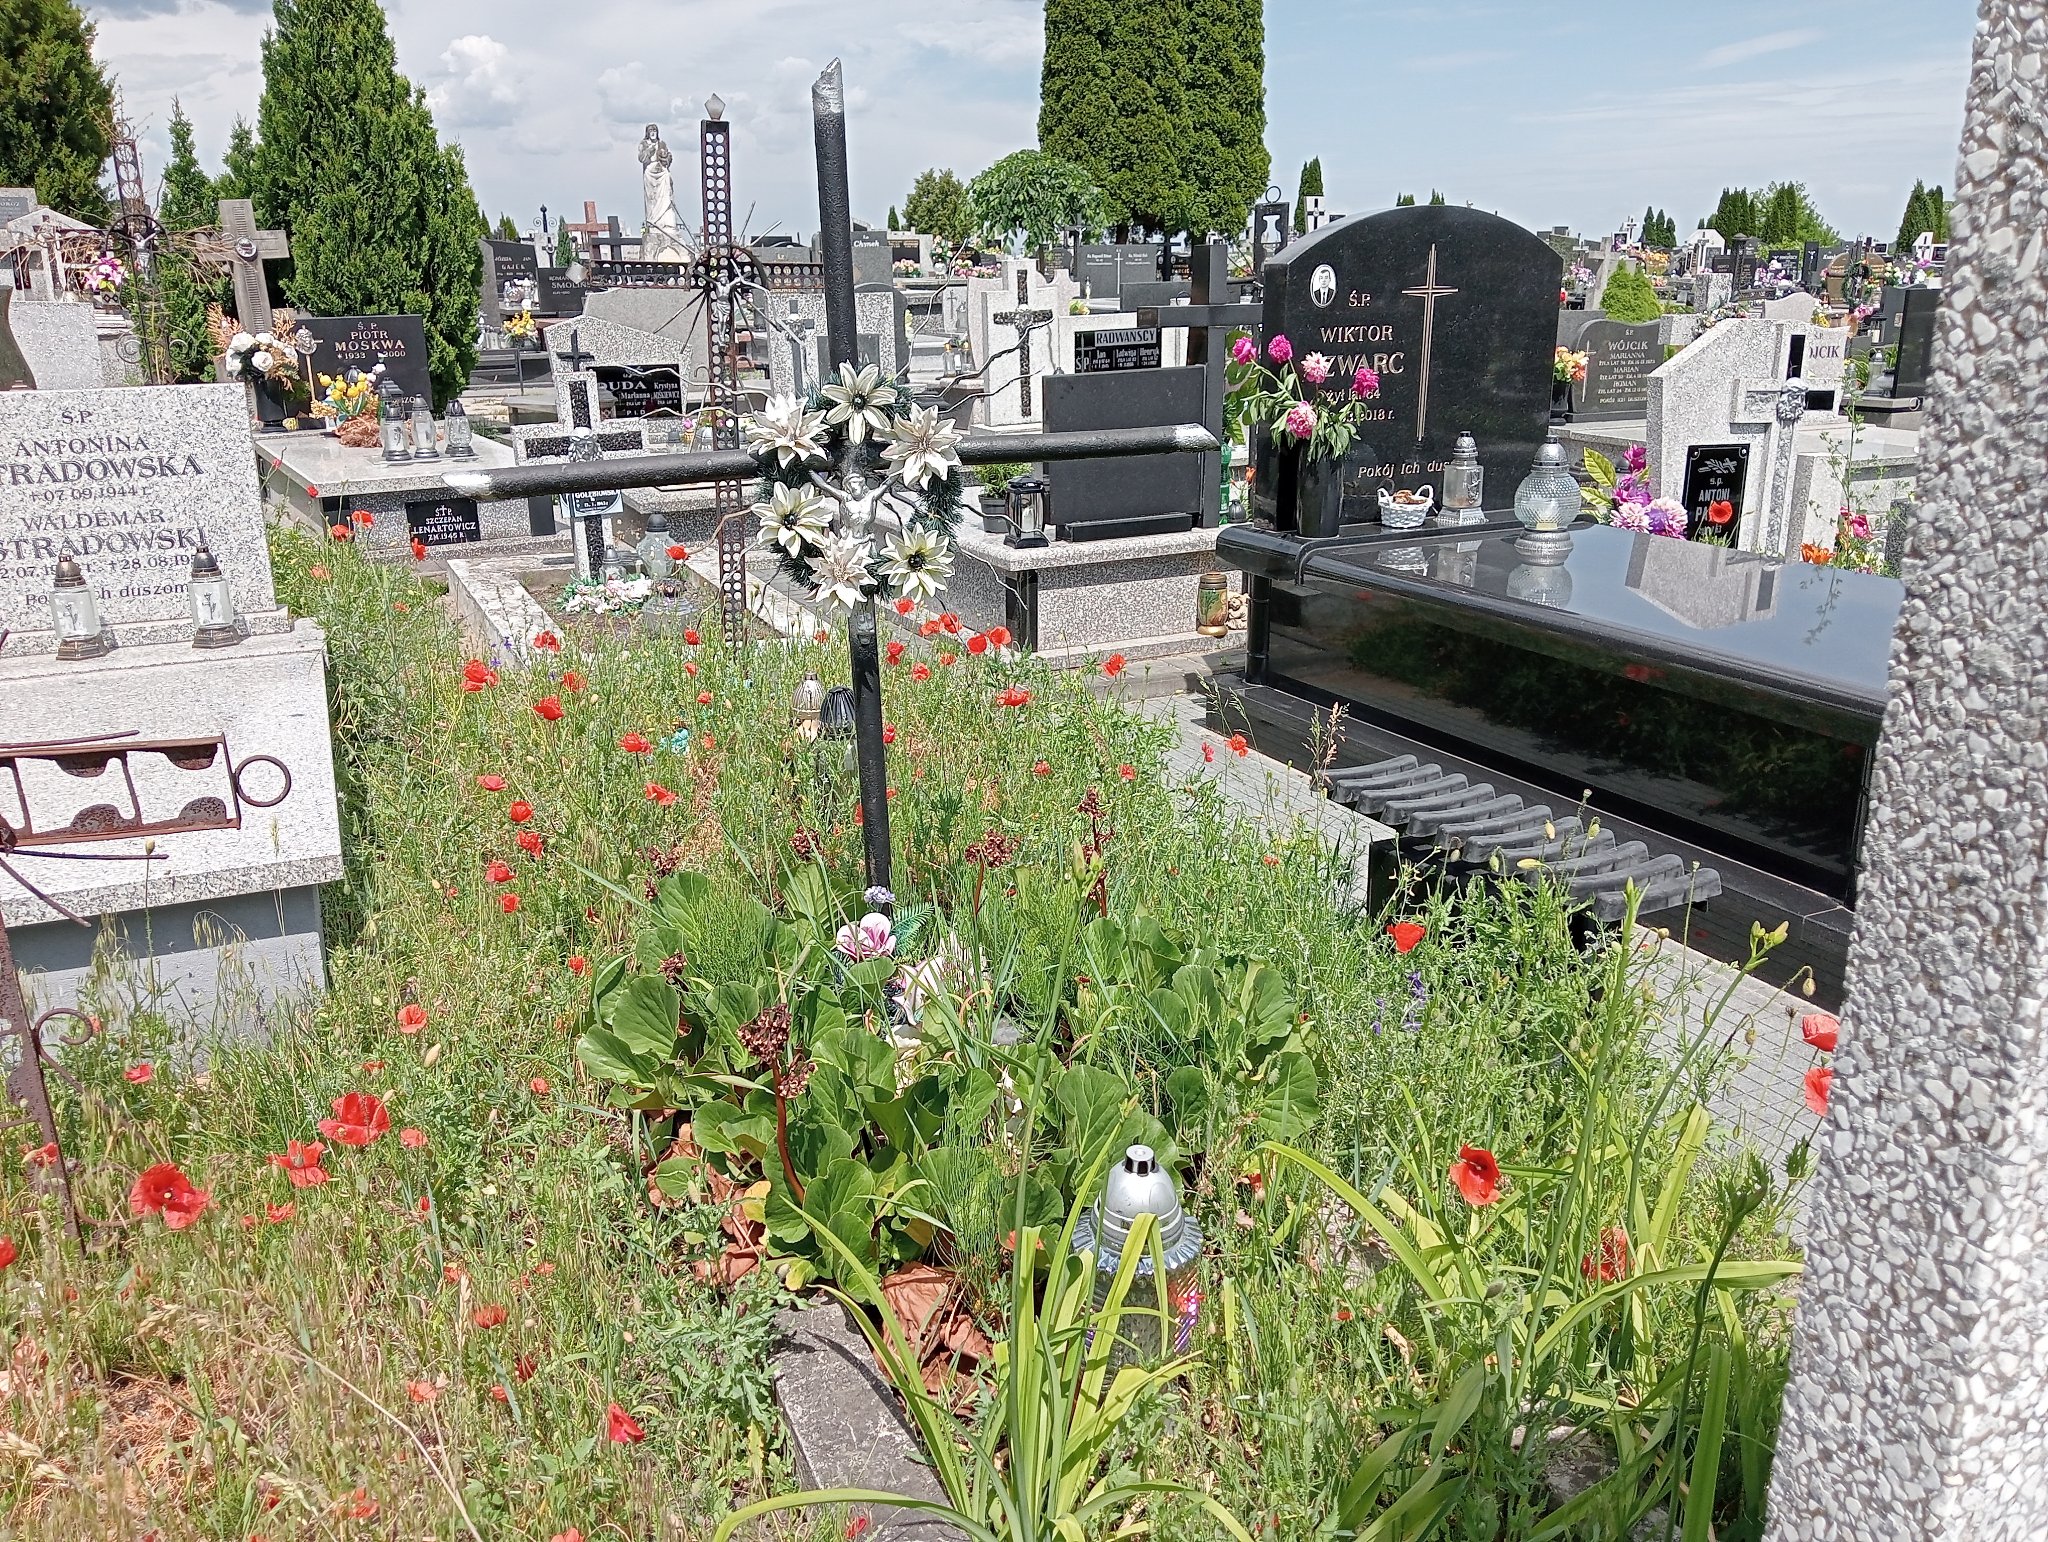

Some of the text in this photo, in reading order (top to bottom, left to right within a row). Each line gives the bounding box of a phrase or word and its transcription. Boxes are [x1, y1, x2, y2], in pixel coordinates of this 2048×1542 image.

[370, 322, 379, 330] P.
[350, 330, 389, 340] PIOTR
[1320, 324, 1394, 343] WIKTOR
[335, 340, 405, 352] MOSKWA
[1607, 339, 1649, 351] WÓJCIK
[1809, 345, 1841, 359] JCIK
[1609, 352, 1645, 360] MARIANNA
[1325, 352, 1405, 378] ZWARC
[14, 435, 152, 458] ANTONINA
[1357, 463, 1395, 478] Pokój
[1400, 462, 1420, 475] Ich
[1698, 487, 1731, 502] ANTONI
[21, 507, 167, 533] WALDEMAR
[425, 515, 463, 525] SZCZEPAN
[413, 521, 477, 534] LENARTOWICZ
[119, 582, 189, 599] duszom
